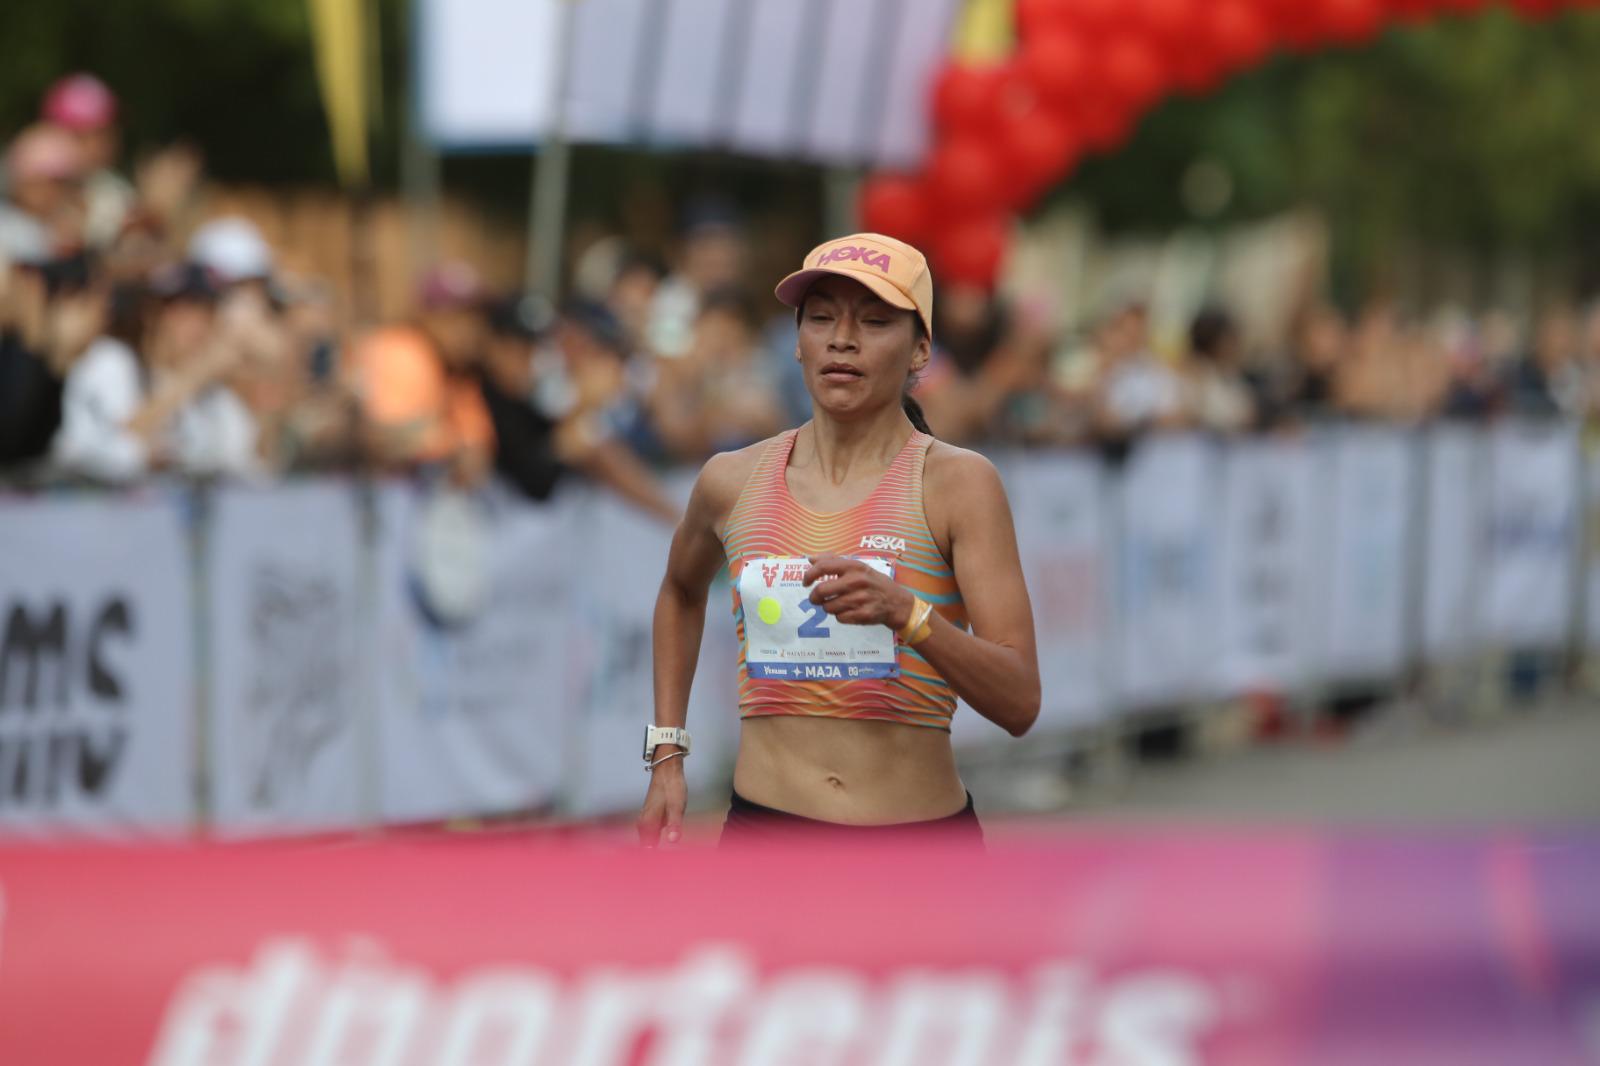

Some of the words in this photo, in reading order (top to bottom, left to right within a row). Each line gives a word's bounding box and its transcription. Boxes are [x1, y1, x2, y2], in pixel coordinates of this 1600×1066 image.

[816, 245, 891, 273] HOKA
[859, 535, 906, 552] HOKA
[797, 598, 831, 639] 2
[805, 665, 842, 678] MAJA
